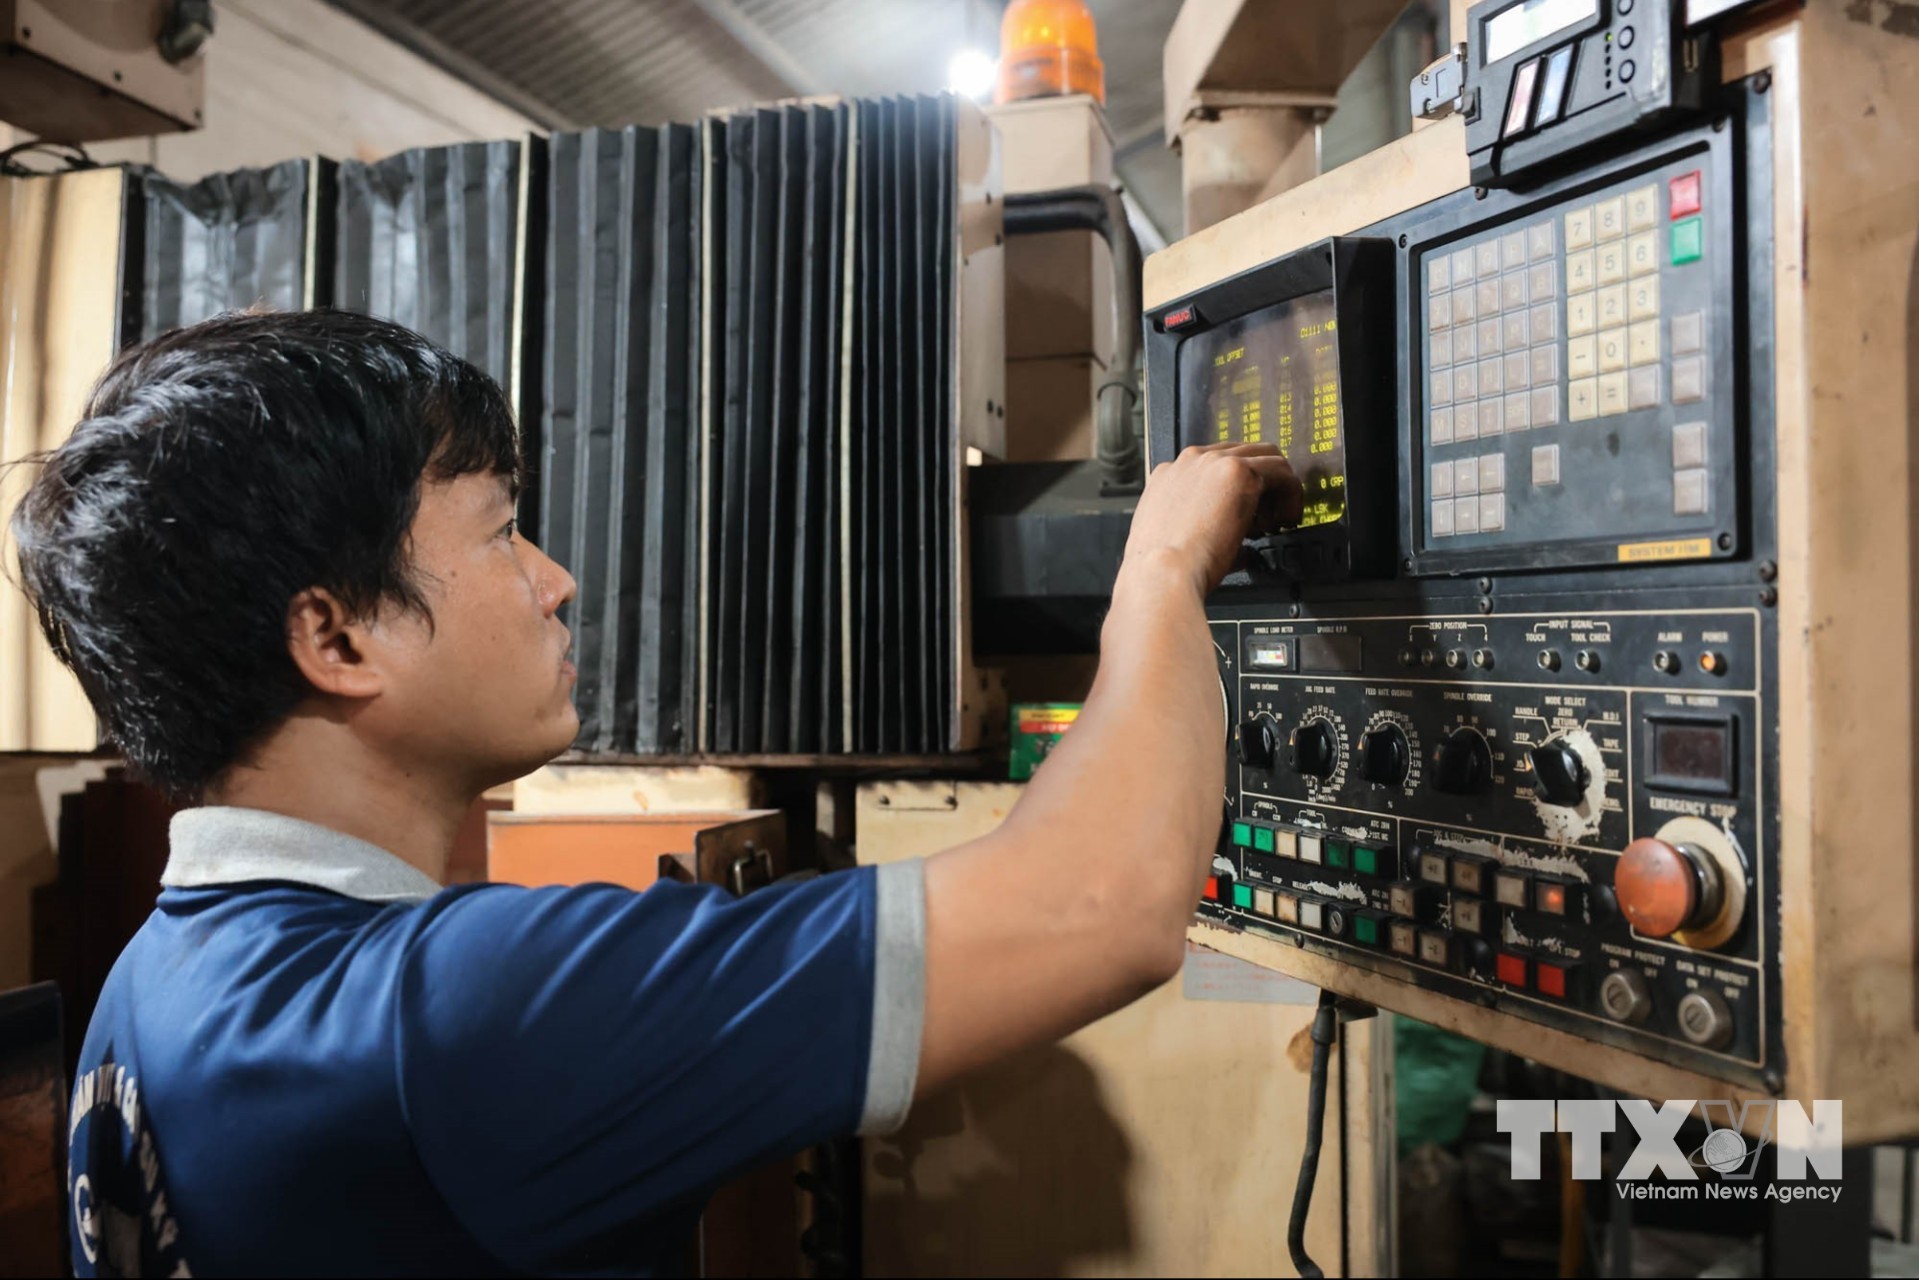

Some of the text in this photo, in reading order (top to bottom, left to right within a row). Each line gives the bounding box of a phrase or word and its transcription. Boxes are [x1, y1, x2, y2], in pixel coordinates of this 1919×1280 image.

[1635, 199, 1646, 216] 9
[1604, 211, 1614, 227] 8
[1573, 223, 1582, 236] 7
[1636, 244, 1646, 261] 6
[1604, 255, 1615, 271] 5
[1575, 264, 1584, 278] 4
[1636, 289, 1648, 306] 3
[1578, 306, 1584, 320] 1
[1606, 298, 1616, 314] 2
[1606, 341, 1616, 358] 0
[1310, 441, 1333, 454] 0.000
[1444, 622, 1468, 630] POSITION
[1525, 633, 1546, 642] TOUCH
[1589, 632, 1611, 642] CHECK
[1564, 696, 1586, 706] SELECT
[1515, 707, 1538, 717] HANDLE
[1487, 728, 1497, 737] 100
[1515, 733, 1530, 741] STEP
[1649, 796, 1737, 820] EMERGENCY STOP
